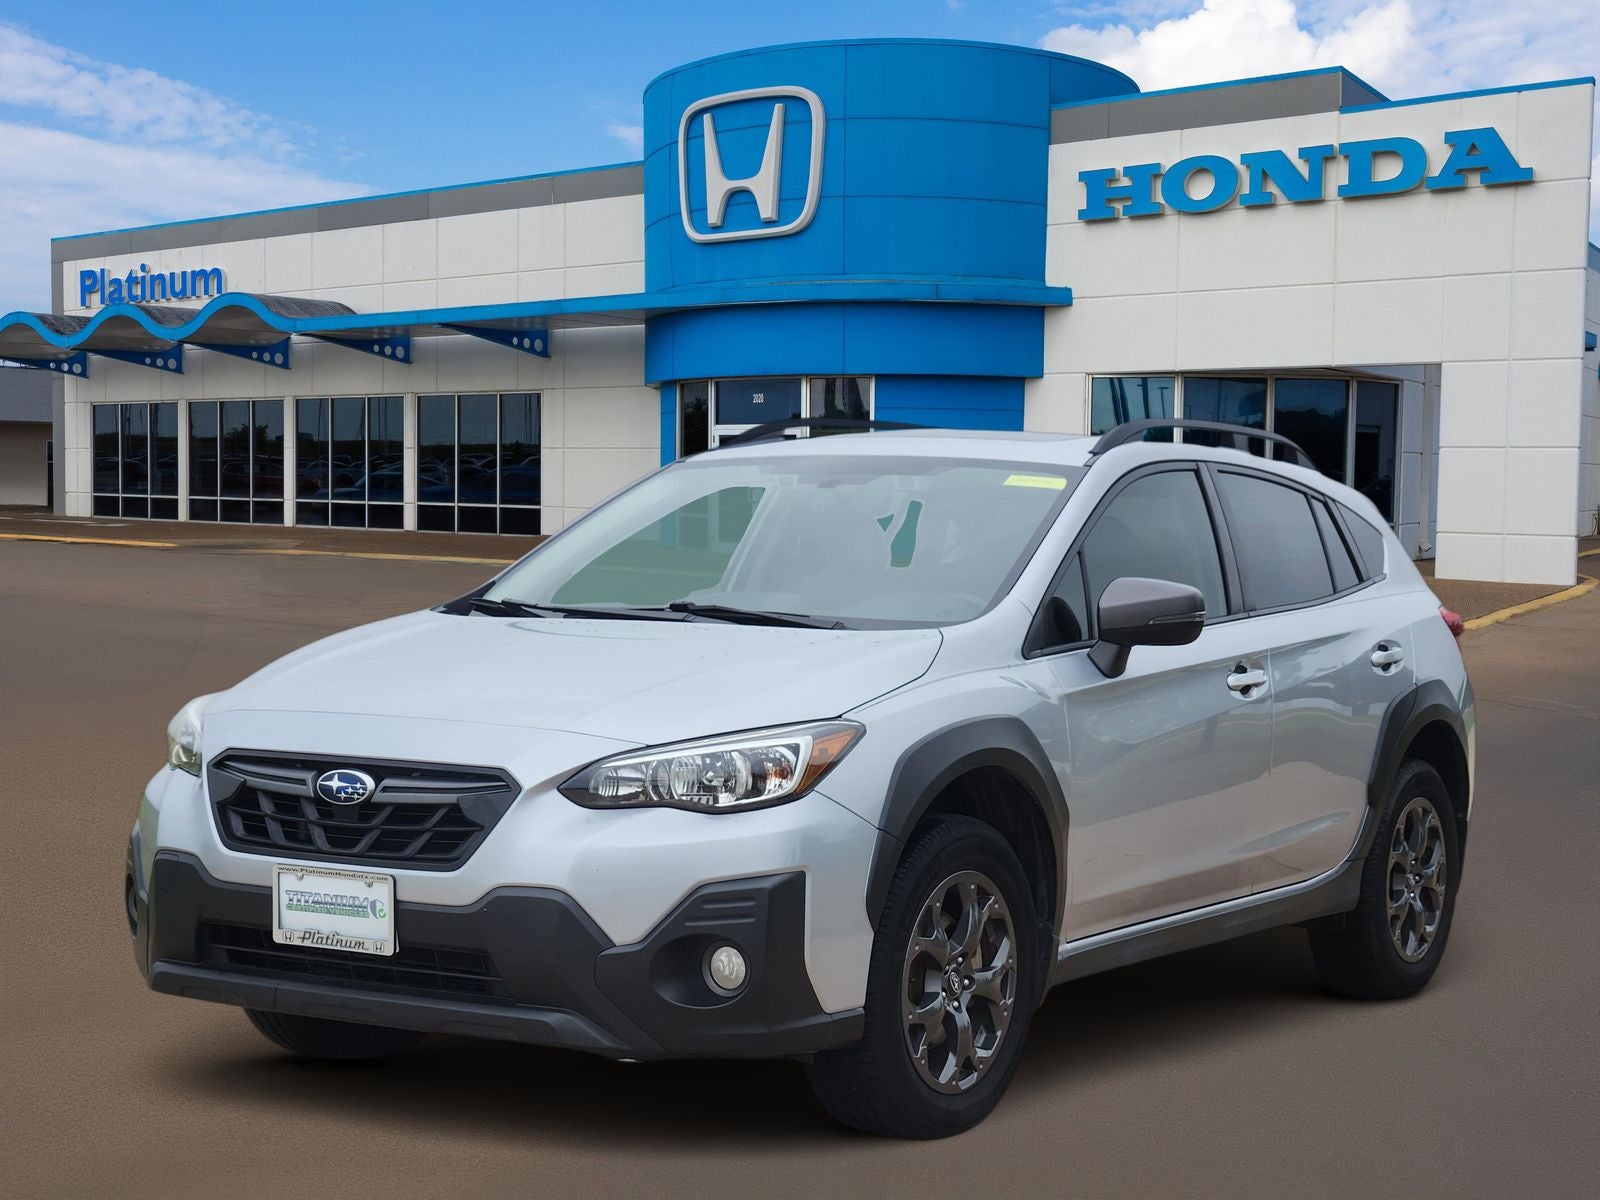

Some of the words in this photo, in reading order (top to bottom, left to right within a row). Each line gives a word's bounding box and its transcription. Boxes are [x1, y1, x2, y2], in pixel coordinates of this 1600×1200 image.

[1078, 126, 1534, 222] HONDA
[79, 263, 224, 307] Platinum
[285, 890, 369, 911] TITANIUM
[297, 930, 369, 950] Platinum
